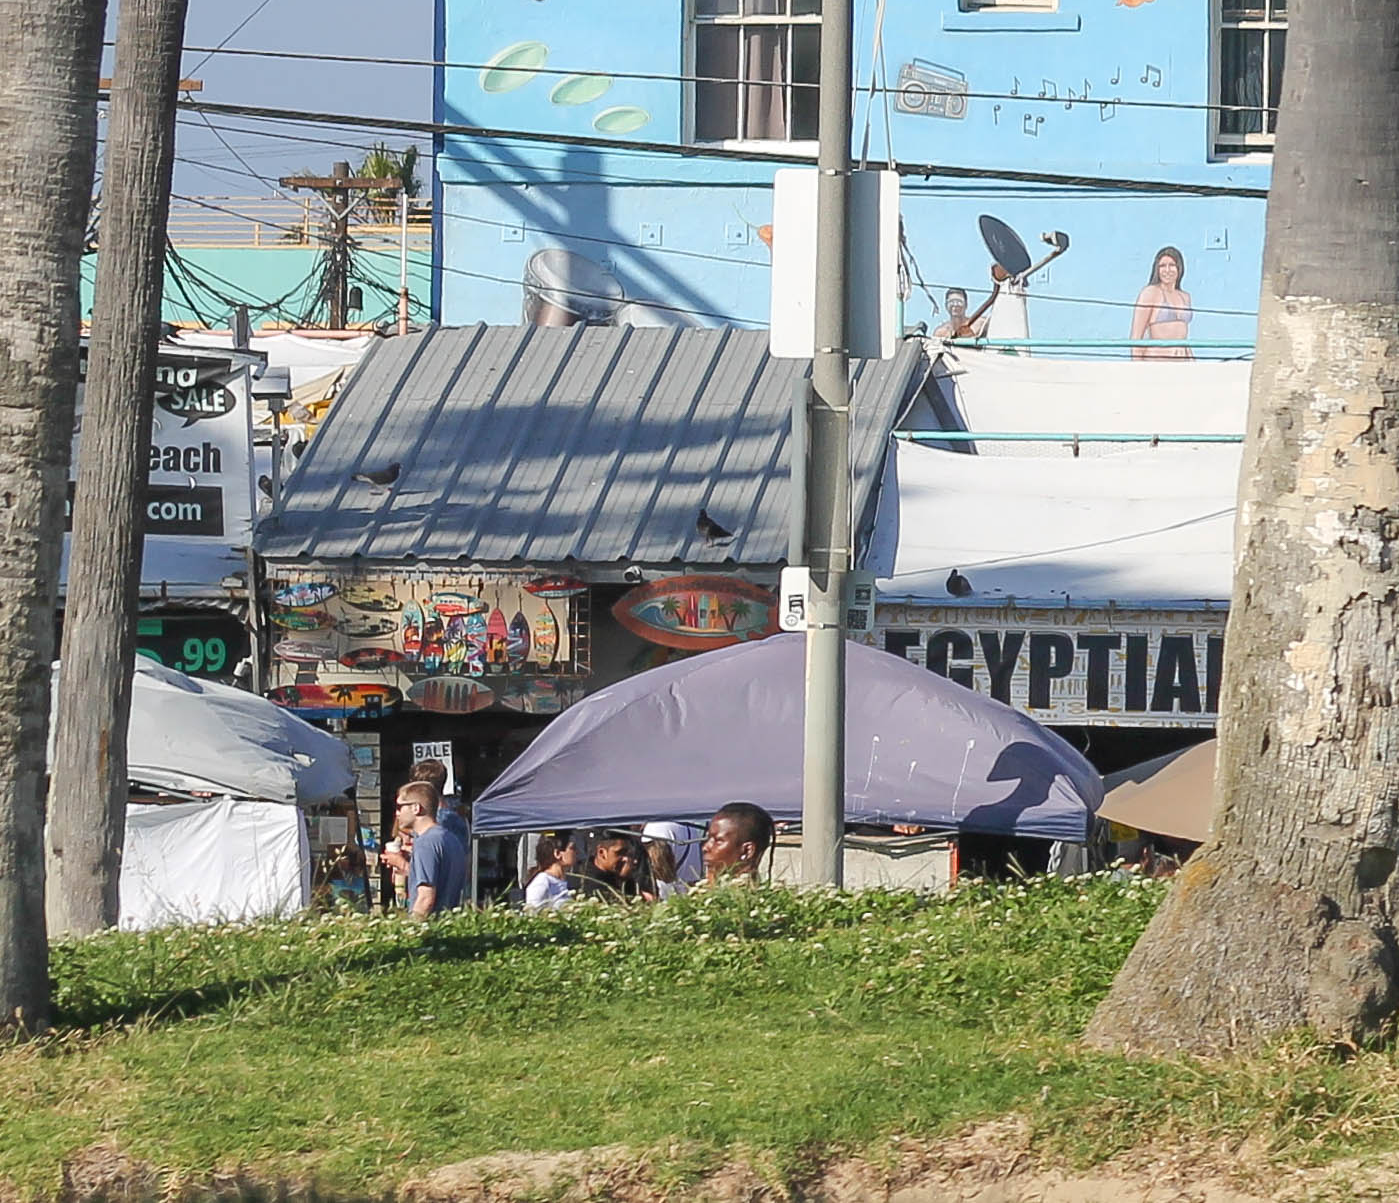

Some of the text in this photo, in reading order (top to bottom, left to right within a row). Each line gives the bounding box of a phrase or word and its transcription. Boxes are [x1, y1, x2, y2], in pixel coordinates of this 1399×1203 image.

[171, 389, 225, 412] SALE
[150, 443, 221, 473] each
[414, 742, 450, 759] SALE
